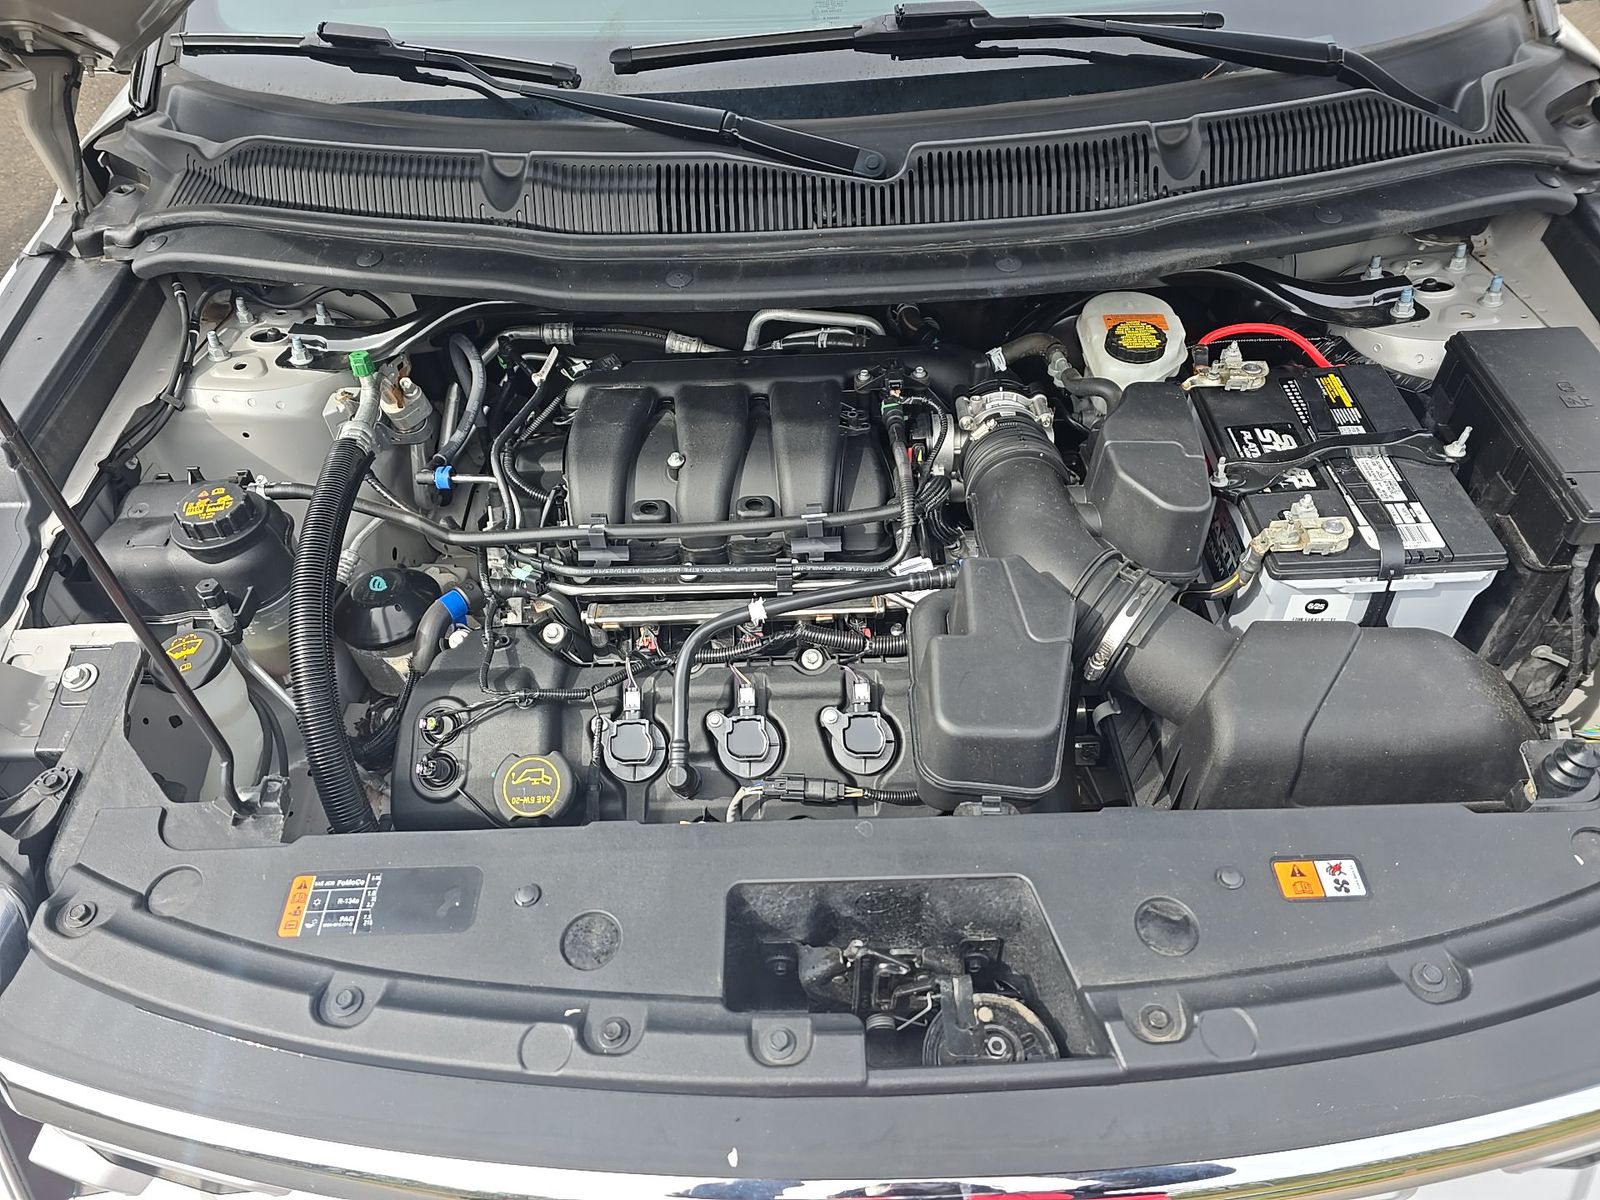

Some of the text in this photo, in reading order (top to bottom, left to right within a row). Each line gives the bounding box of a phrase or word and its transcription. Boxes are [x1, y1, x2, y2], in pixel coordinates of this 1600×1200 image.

[536, 795, 551, 803] SAE
[336, 878, 366, 887] FoMoCo
[337, 897, 360, 905] R-134a
